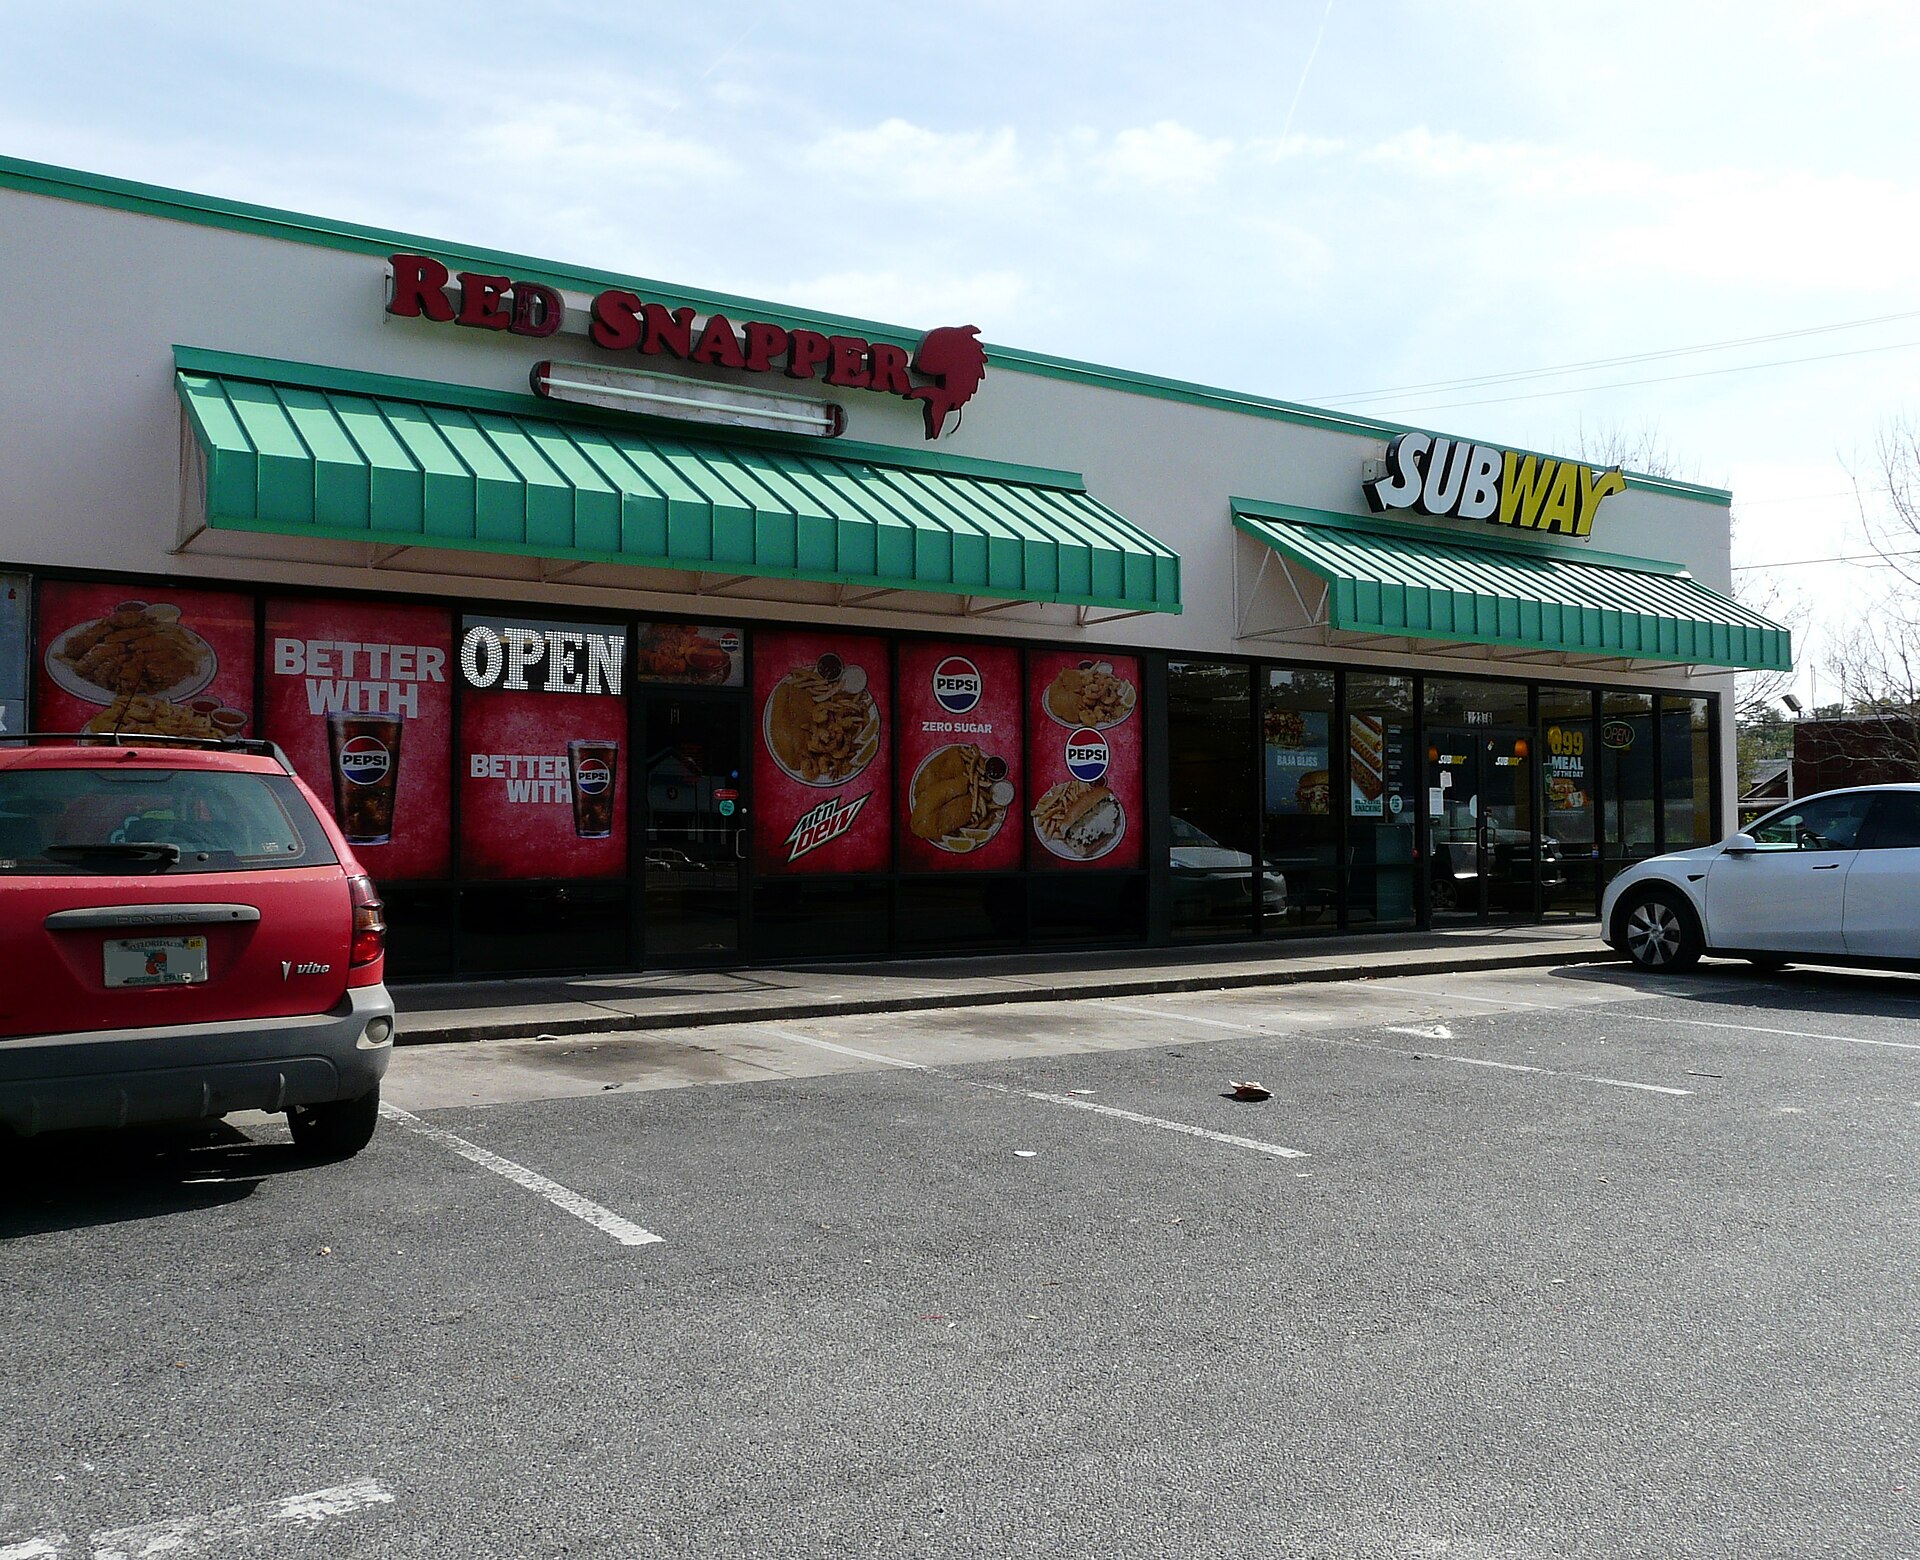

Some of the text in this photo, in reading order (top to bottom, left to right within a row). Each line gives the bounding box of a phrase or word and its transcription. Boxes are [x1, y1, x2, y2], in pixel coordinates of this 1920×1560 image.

[387, 253, 918, 396] RED SNAPPER
[1364, 432, 1627, 537] SUBWAY
[274, 637, 446, 683] BETTER
[460, 625, 625, 696] OPEN
[936, 678, 978, 691] PEPSI
[305, 678, 418, 719] WITH
[922, 721, 993, 734] ZERO SUGAR
[1604, 726, 1632, 743] OPEN
[342, 754, 387, 767] PEPSI
[1068, 748, 1107, 760] PEPSI
[1438, 754, 1467, 765] SUBWAY
[470, 753, 571, 780] BETTER
[1495, 756, 1523, 766] SUBWAY
[1552, 756, 1584, 771] MEAL
[578, 772, 608, 781] PEPSI
[1560, 770, 1573, 778] THE
[506, 779, 573, 804] WITH
[115, 912, 199, 924] PONTIAC
[296, 962, 331, 975] vibe
